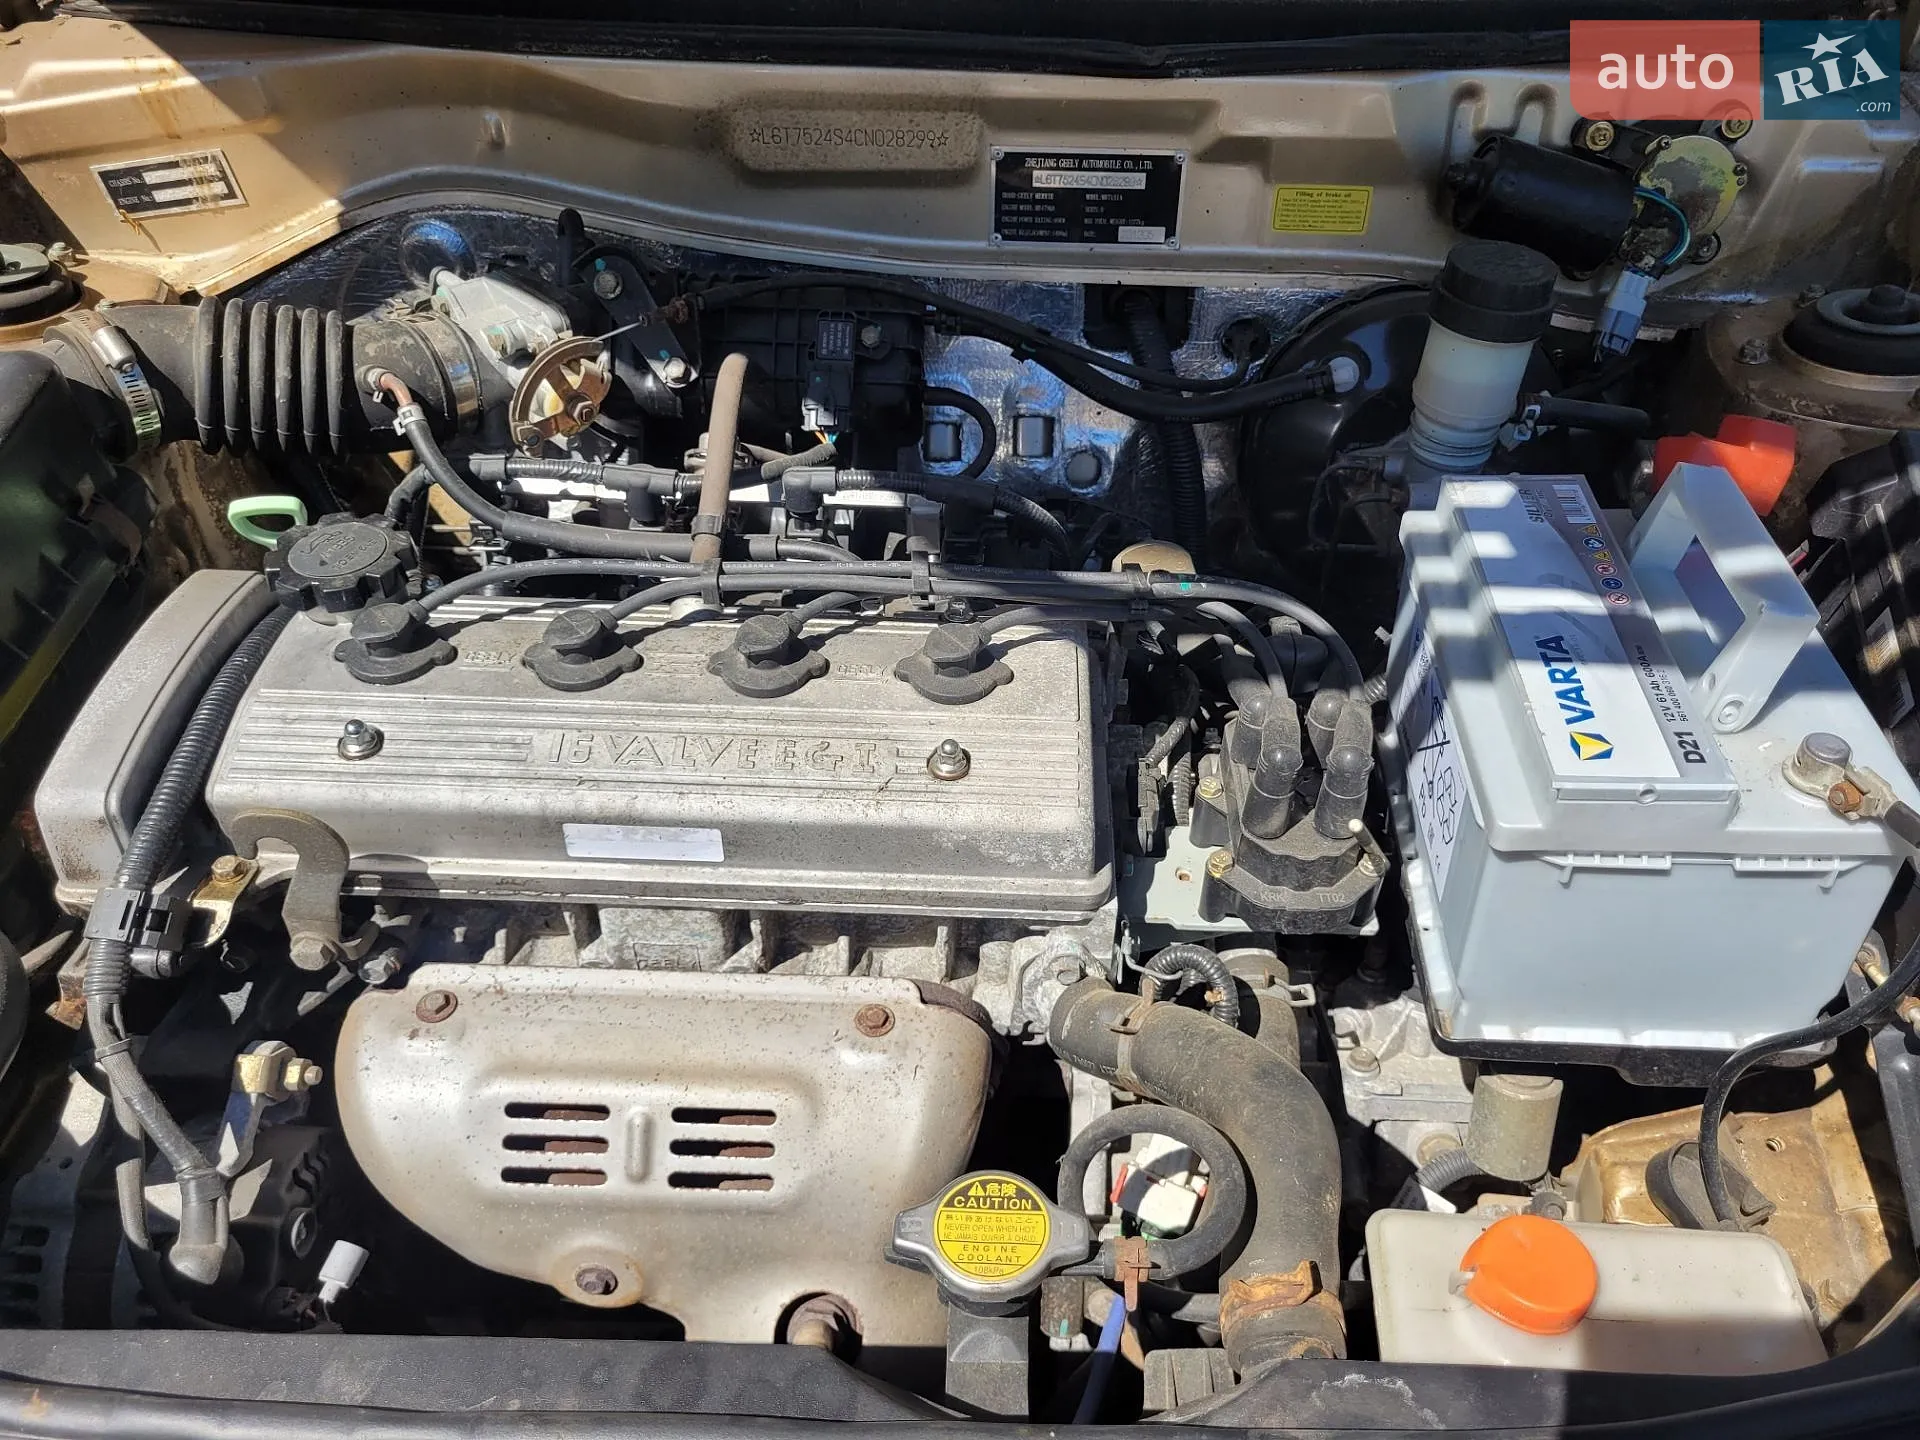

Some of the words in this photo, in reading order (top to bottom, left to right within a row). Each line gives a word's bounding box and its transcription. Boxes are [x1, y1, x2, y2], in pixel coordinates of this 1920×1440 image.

[1025, 158, 1057, 169] ZHEJIANG
[1059, 158, 1079, 169] GEELY
[1081, 159, 1122, 169] AUTOMOBILE
[1535, 635, 1595, 726] VARTA
[1673, 731, 1707, 764] D21
[986, 1183, 1017, 1198] 危険
[953, 1196, 1032, 1210] CAUTION
[944, 1223, 970, 1232] NEVER
[972, 1224, 994, 1233] OPEN
[995, 1225, 1018, 1233] WHEN
[962, 1245, 1018, 1254] ENGINE
[957, 1253, 1022, 1264] COOLANT
